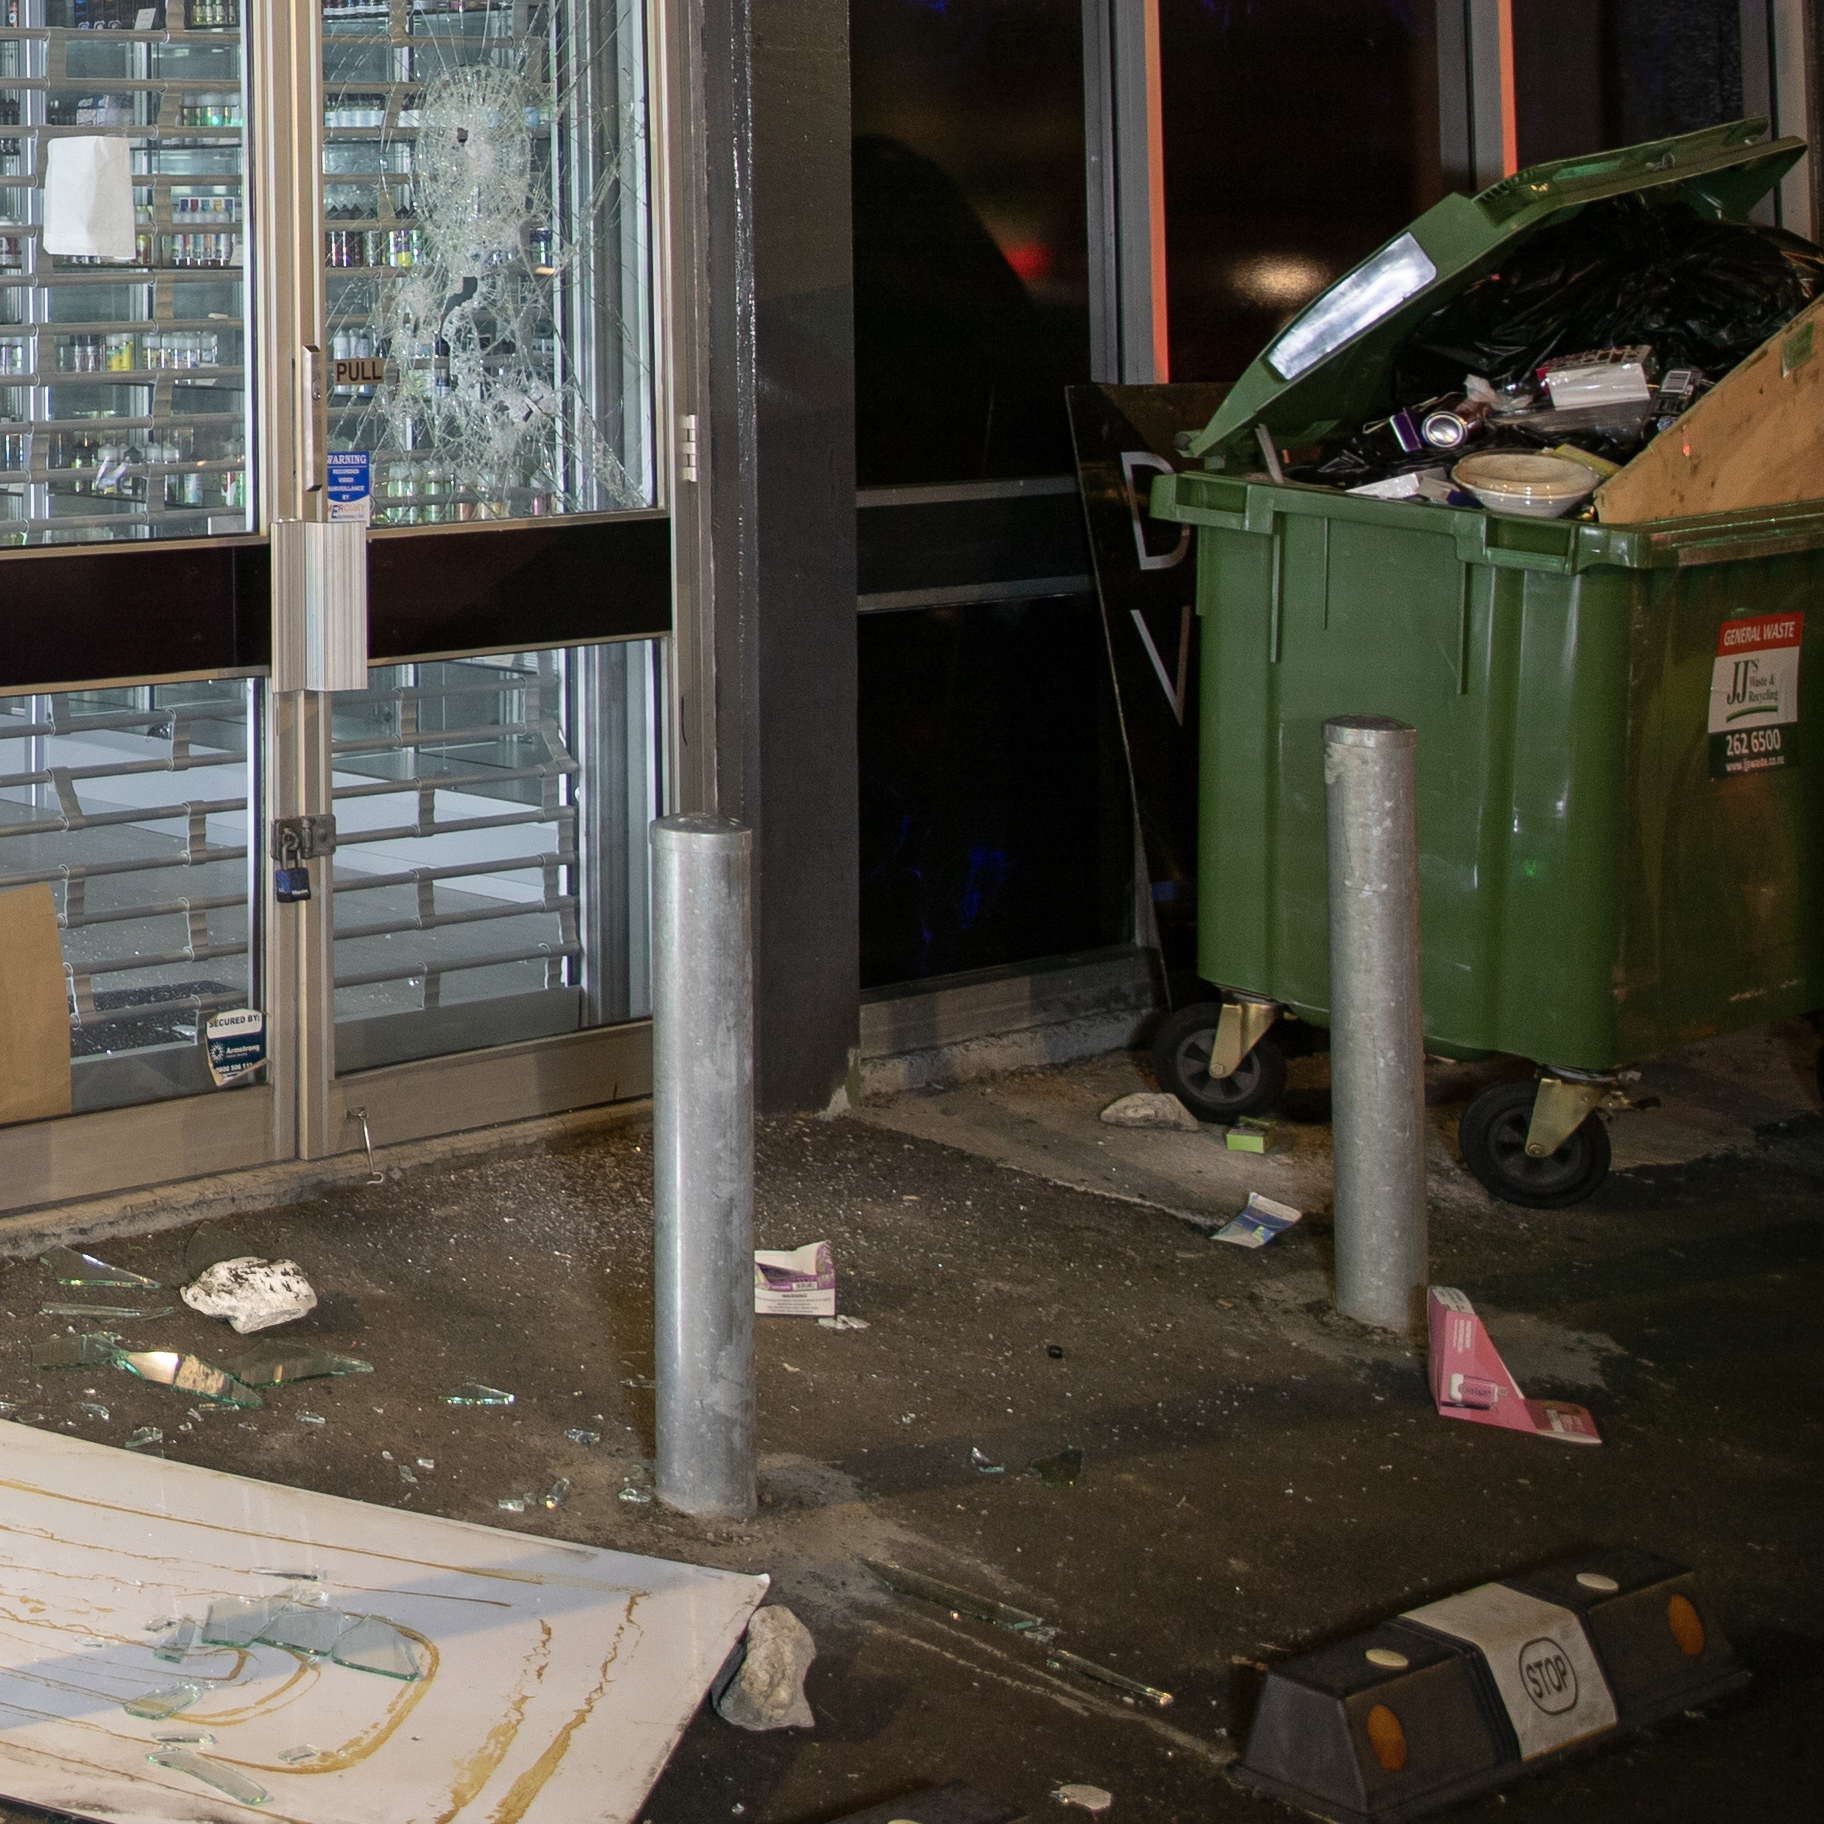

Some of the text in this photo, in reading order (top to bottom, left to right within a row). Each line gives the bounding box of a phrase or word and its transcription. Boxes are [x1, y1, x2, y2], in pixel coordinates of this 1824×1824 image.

[336, 361, 382, 382] PULL
[1723, 621, 1795, 647] GENERAL WASTE
[1749, 674, 1775, 688] Waste &
[1748, 690, 1779, 705] Recycling
[1726, 728, 1782, 757] 262 6500
[209, 1013, 261, 1028] SECURED BY:
[226, 1044, 260, 1054] Armstrong
[1525, 1654, 1568, 1699] STOP
